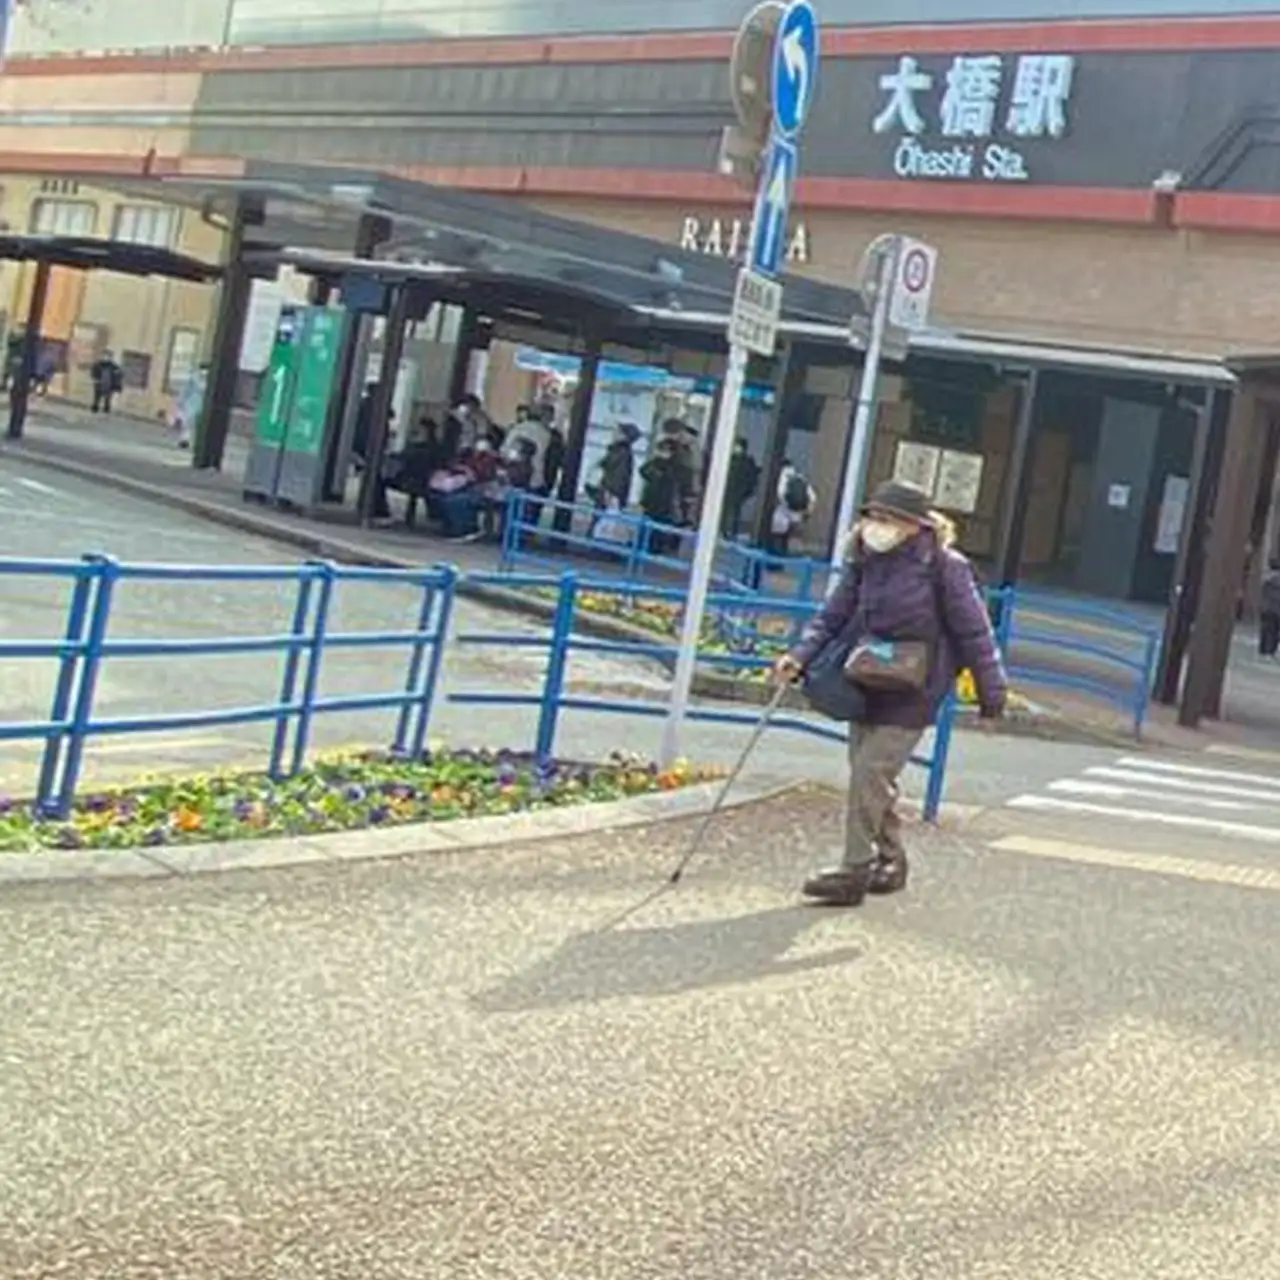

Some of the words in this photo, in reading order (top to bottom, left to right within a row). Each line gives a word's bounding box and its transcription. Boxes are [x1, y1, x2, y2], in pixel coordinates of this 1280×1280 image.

[873, 55, 1074, 137] 大橋駅
[983, 144, 1029, 180] Sta.
[680, 217, 807, 261] RAIA
